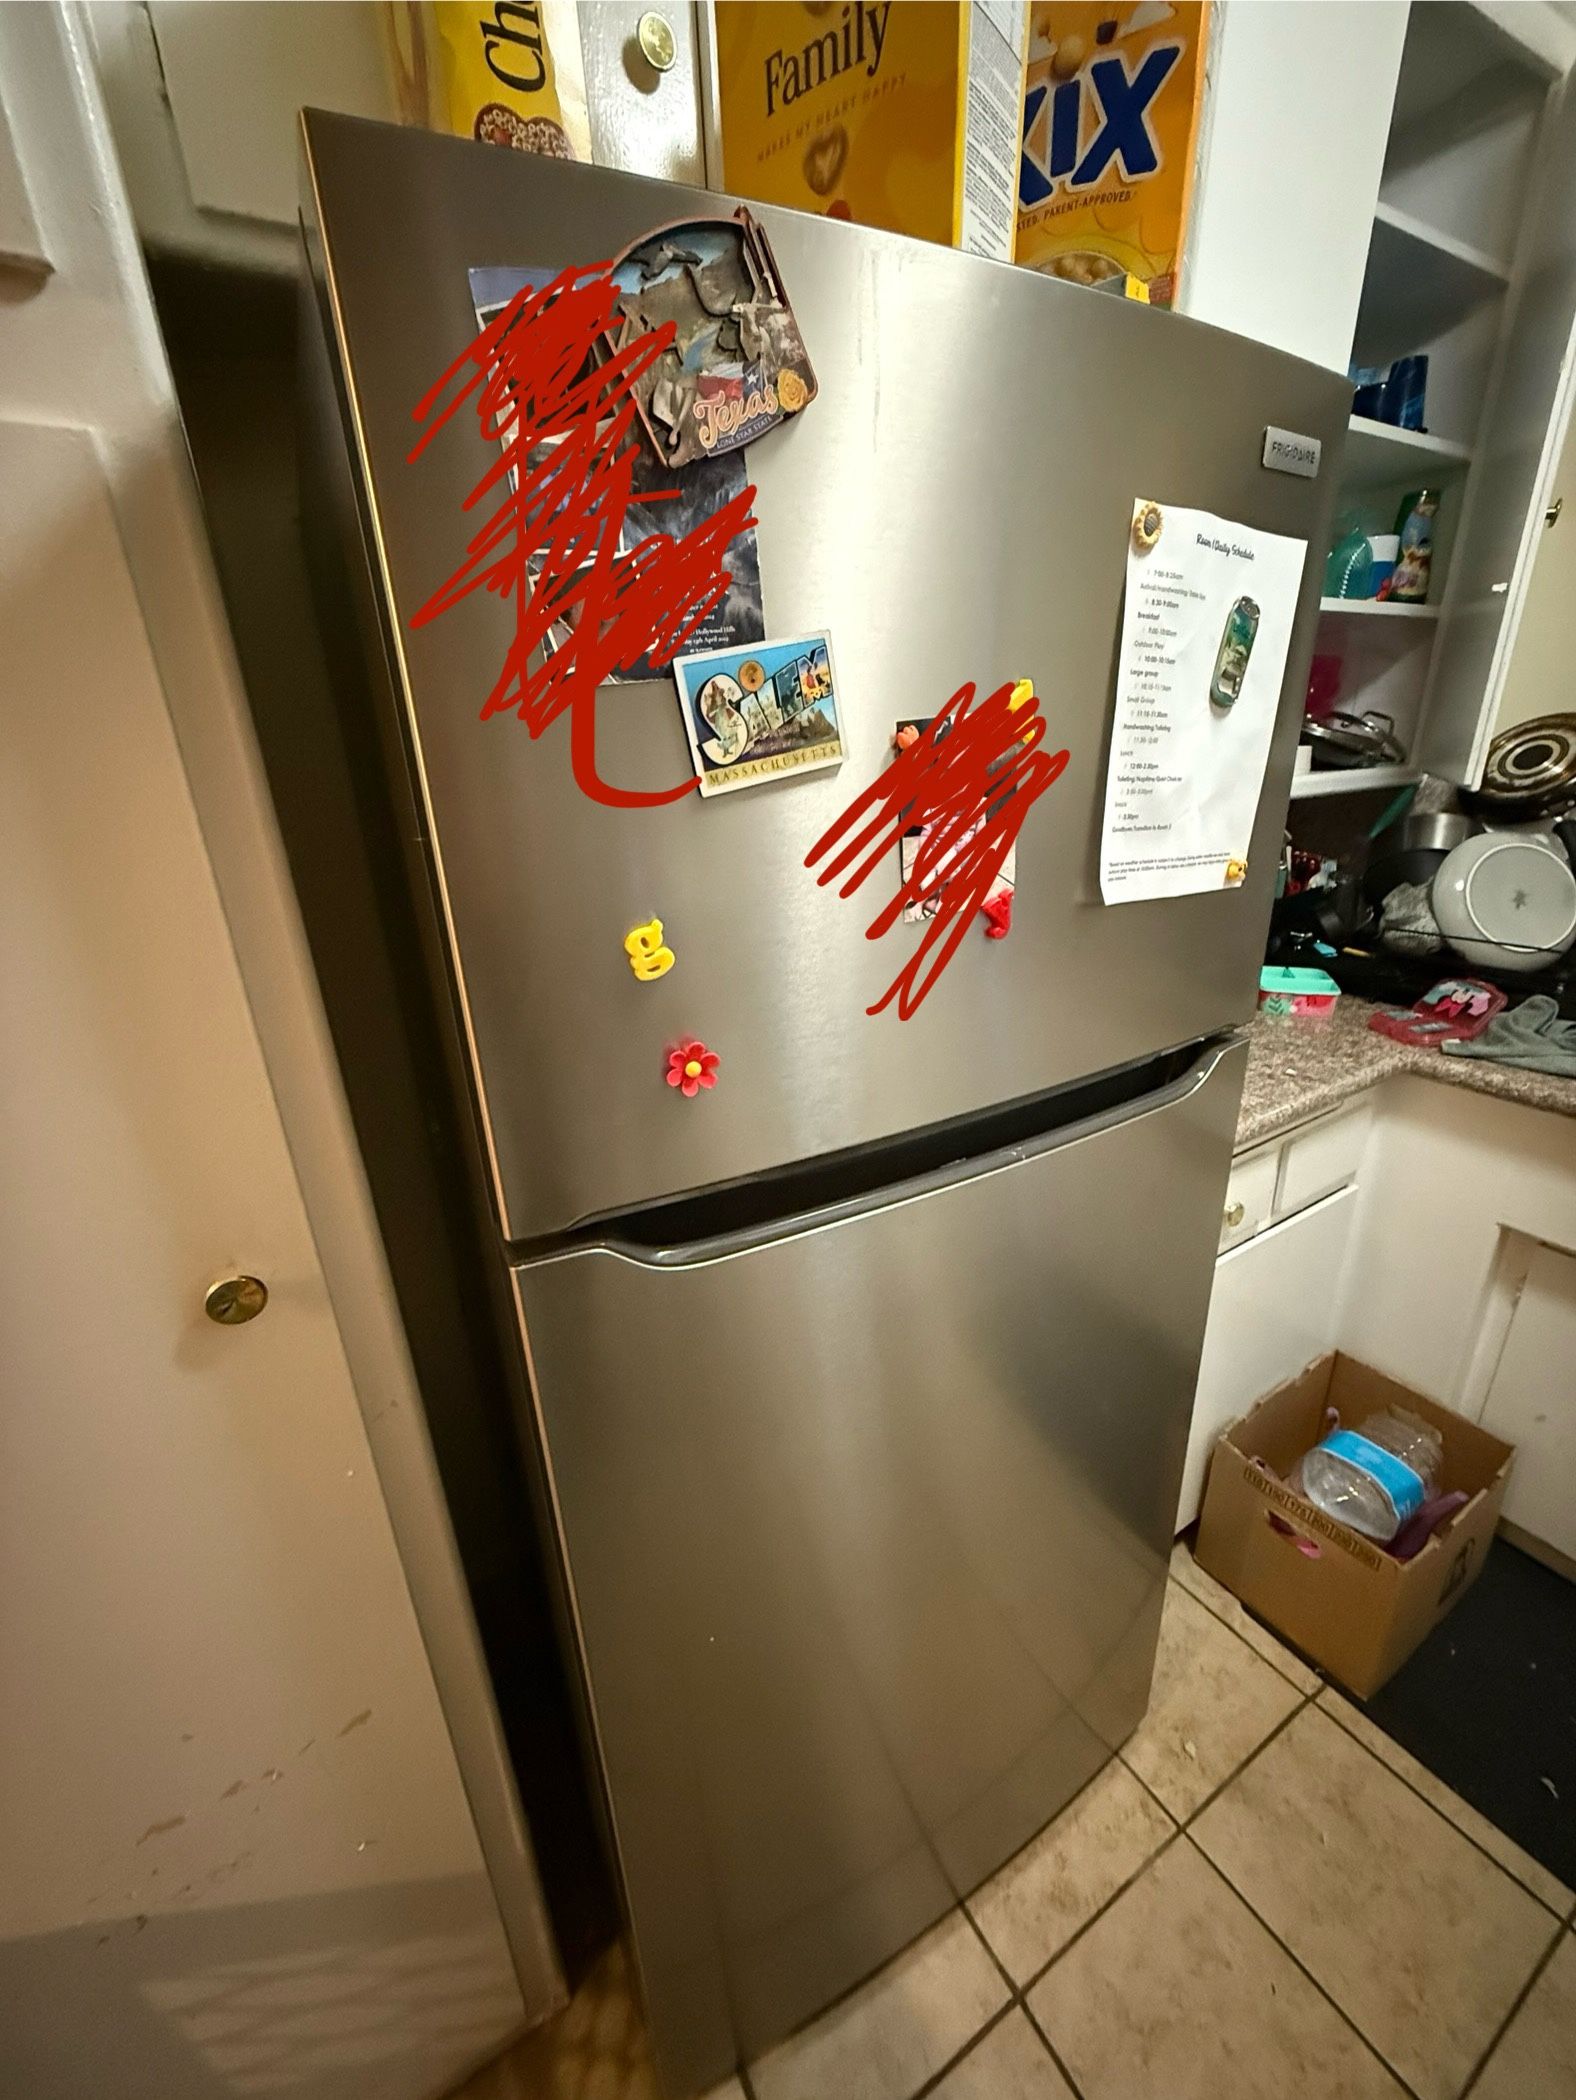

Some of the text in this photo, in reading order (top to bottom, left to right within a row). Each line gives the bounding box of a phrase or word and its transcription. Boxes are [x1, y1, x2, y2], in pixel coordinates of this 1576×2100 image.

[480, 0, 546, 92] Ch
[765, 0, 892, 117] Family
[693, 383, 779, 449] Texas
[716, 415, 773, 450] LONE STAR STATE
[1196, 533, 1212, 548] Room
[1215, 540, 1231, 557] Daily
[1231, 544, 1255, 561] Schedule
[696, 627, 723, 636] Hollywood
[705, 635, 718, 644] April
[694, 644, 834, 767] SALEM
[708, 745, 837, 786] MASSACHUSETTS
[624, 918, 676, 981] g
